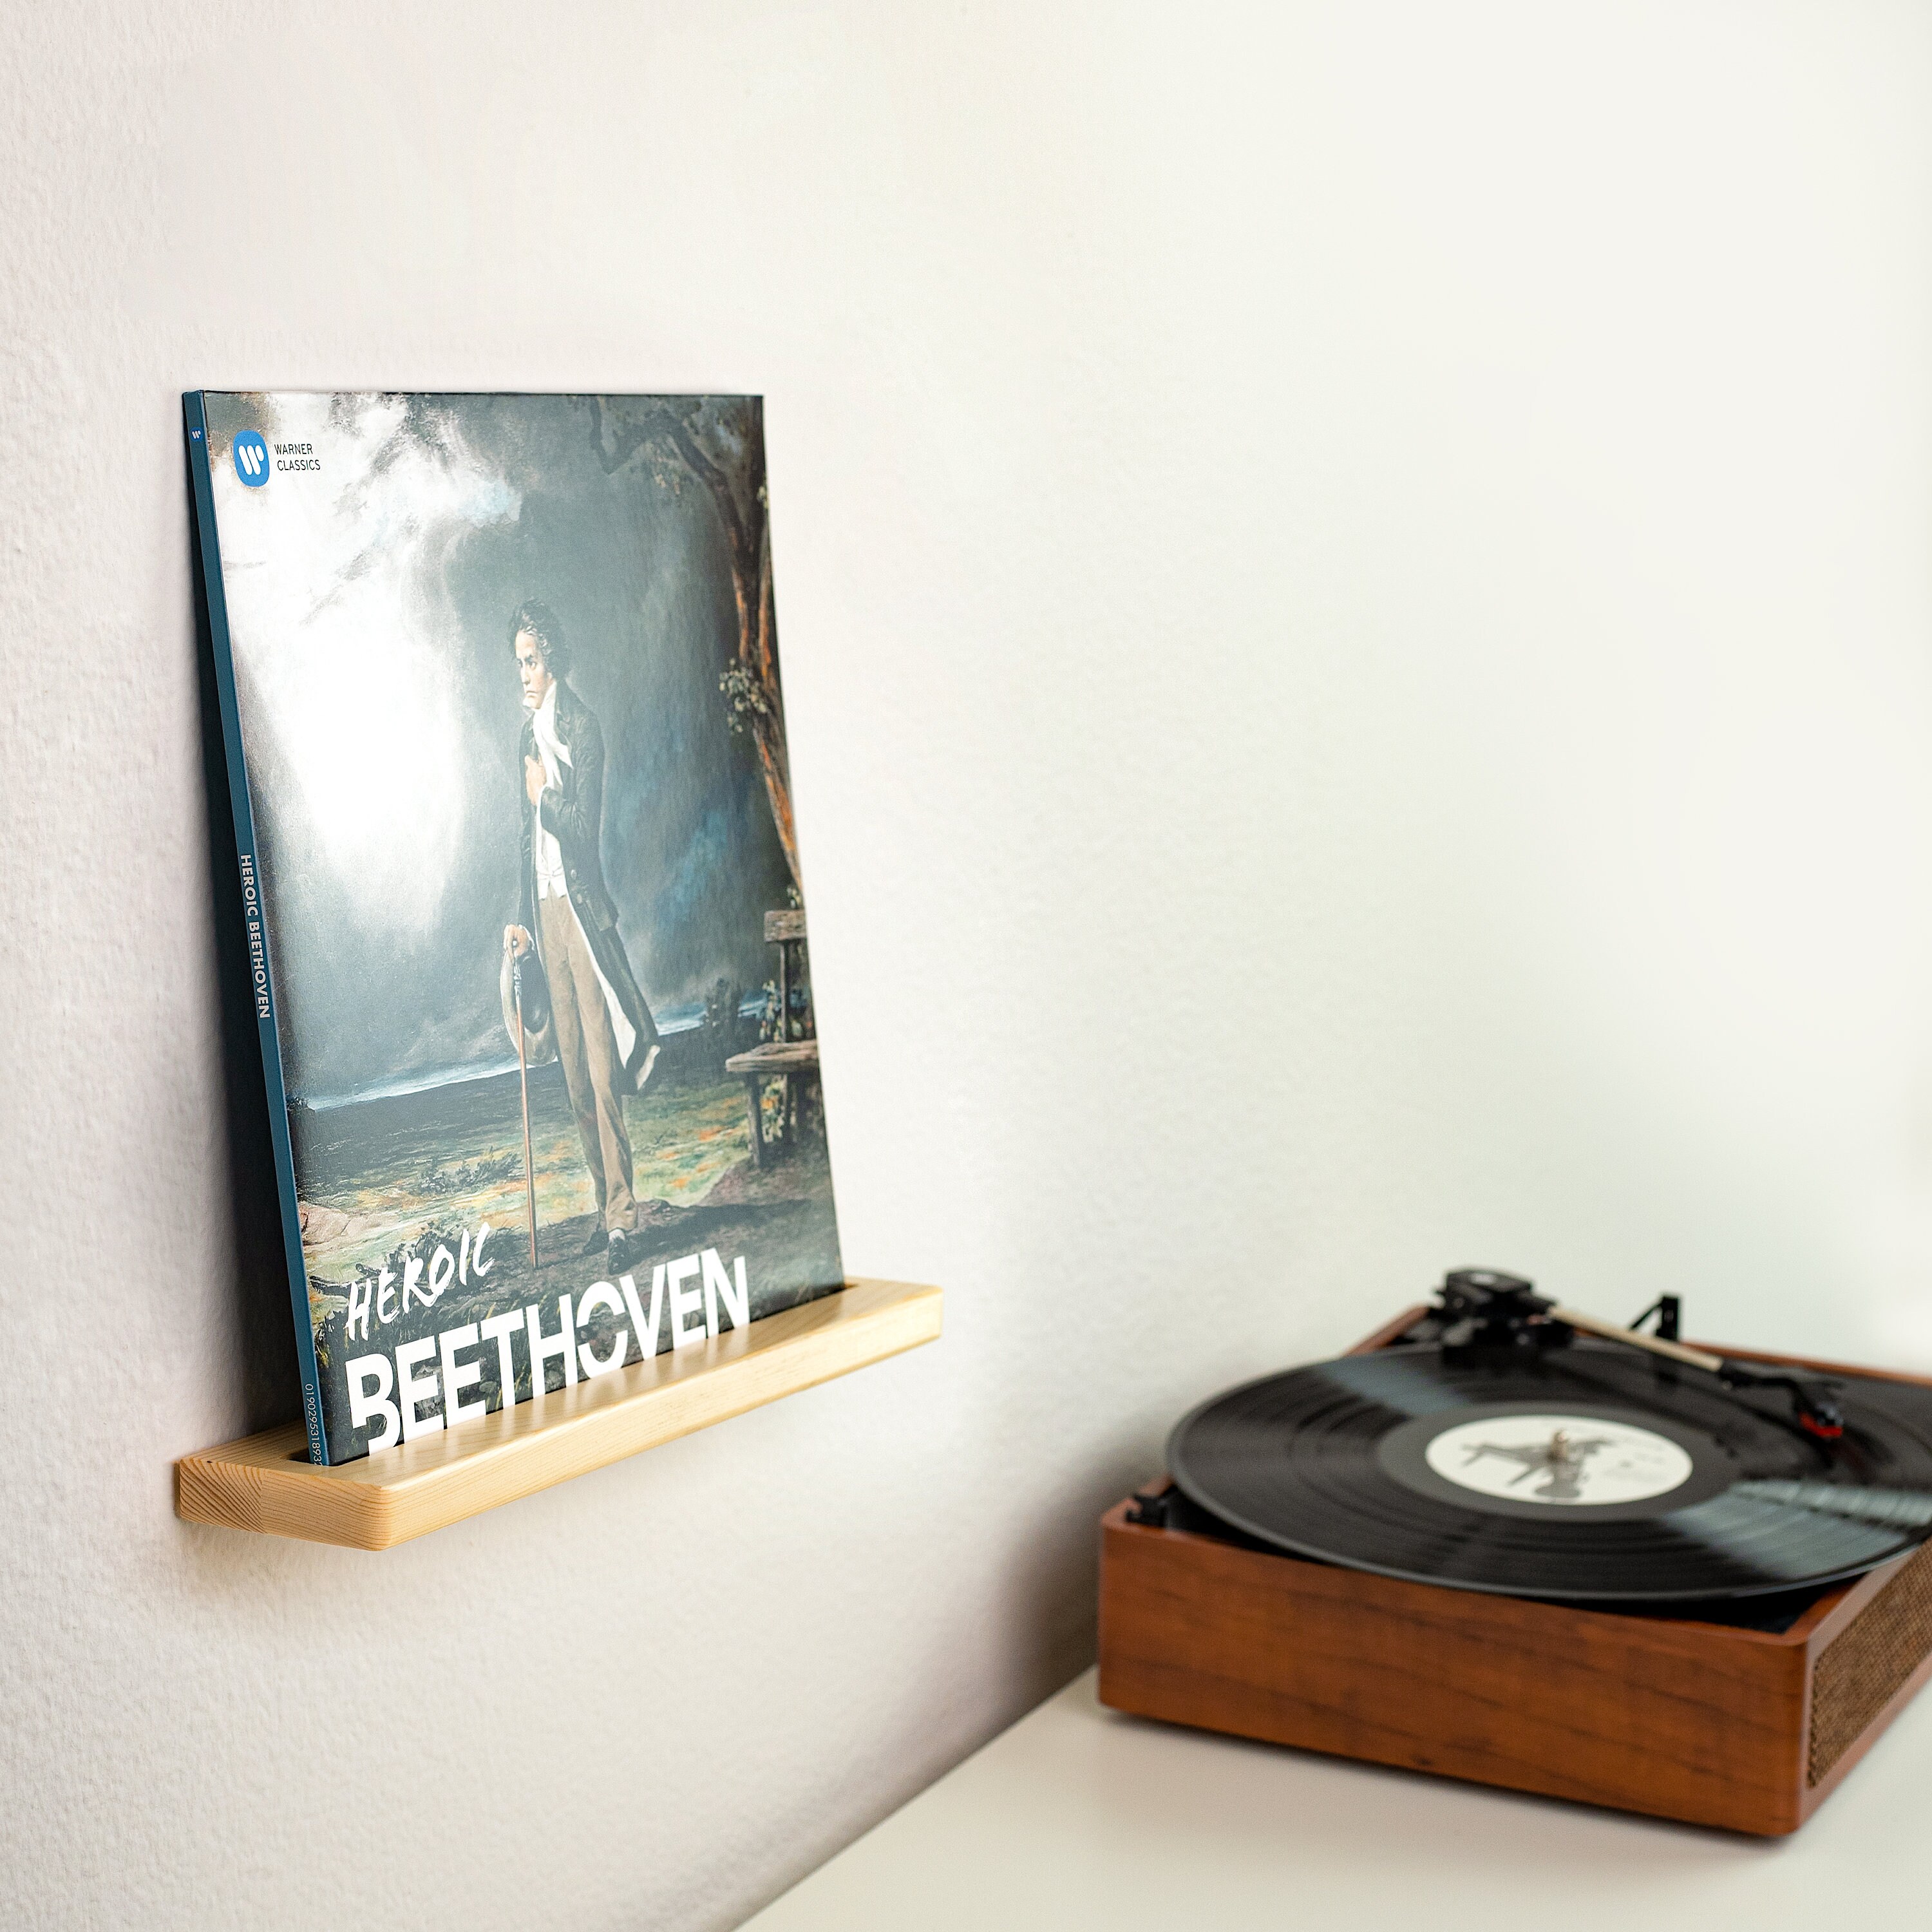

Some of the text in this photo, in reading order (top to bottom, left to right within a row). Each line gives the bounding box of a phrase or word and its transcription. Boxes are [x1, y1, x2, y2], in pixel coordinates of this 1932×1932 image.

[274, 444, 313, 455] WARNER
[277, 460, 321, 471] CLASSICS
[240, 855, 270, 1018] HEROIC BEETHOVEN
[344, 1222, 495, 1341] HEROIC
[345, 1247, 750, 1456] BEETHOVEN
